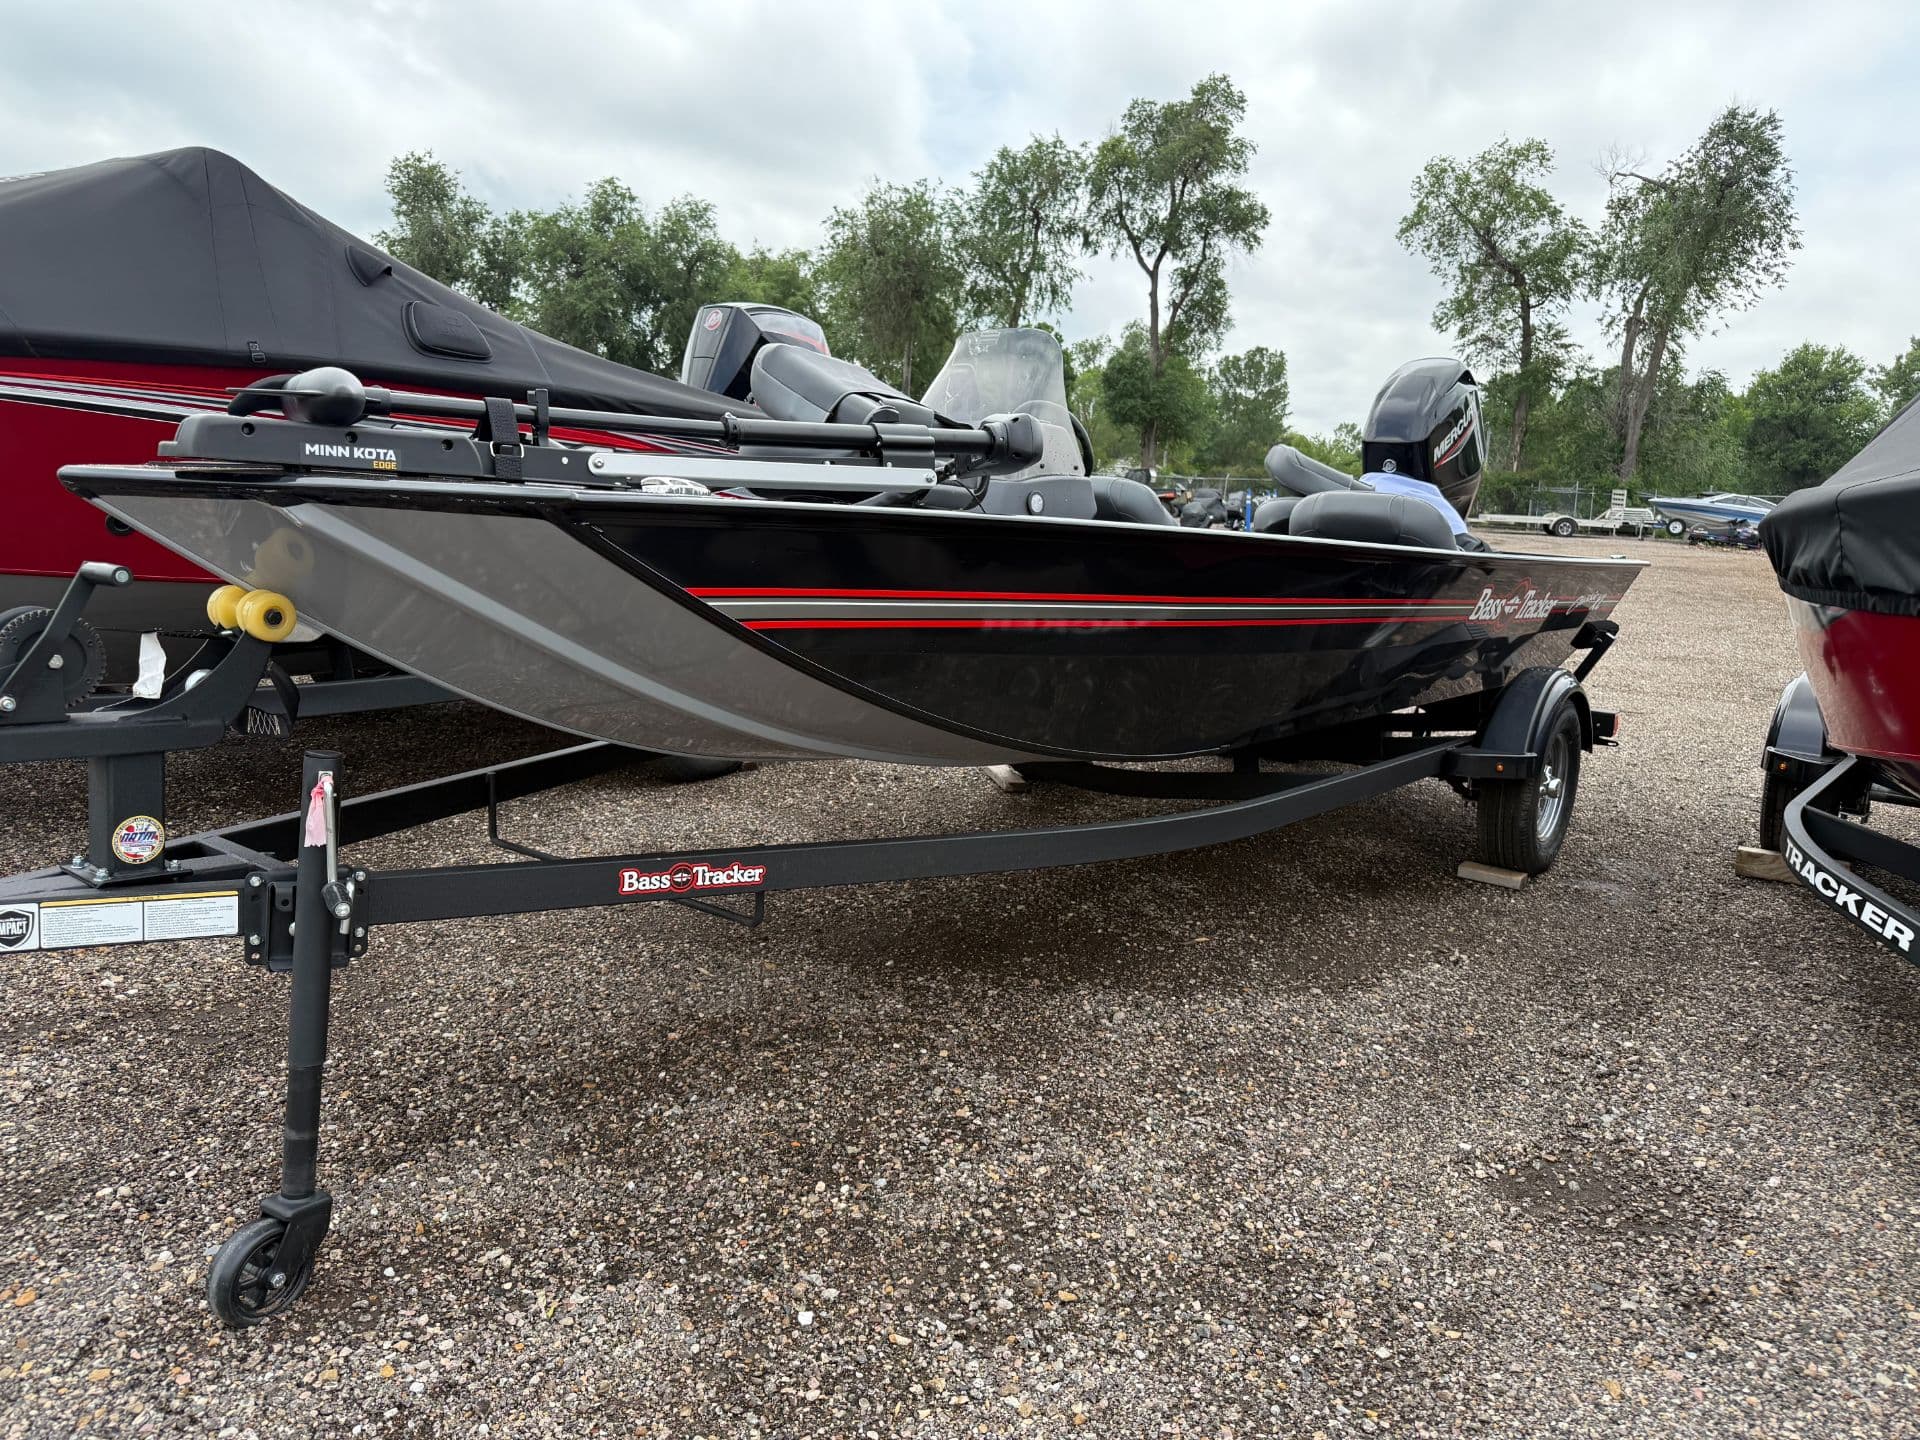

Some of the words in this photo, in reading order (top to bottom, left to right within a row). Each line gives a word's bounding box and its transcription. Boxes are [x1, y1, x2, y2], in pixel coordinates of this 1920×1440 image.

[305, 443, 350, 458] MINN
[353, 447, 397, 461] KOTA
[373, 460, 398, 470] EDGE
[1468, 588, 1505, 620] Bass
[1514, 589, 1559, 619] Tracker
[622, 871, 671, 892] Bass
[693, 864, 764, 886] Tracker
[1785, 838, 1915, 952] TRACKER
